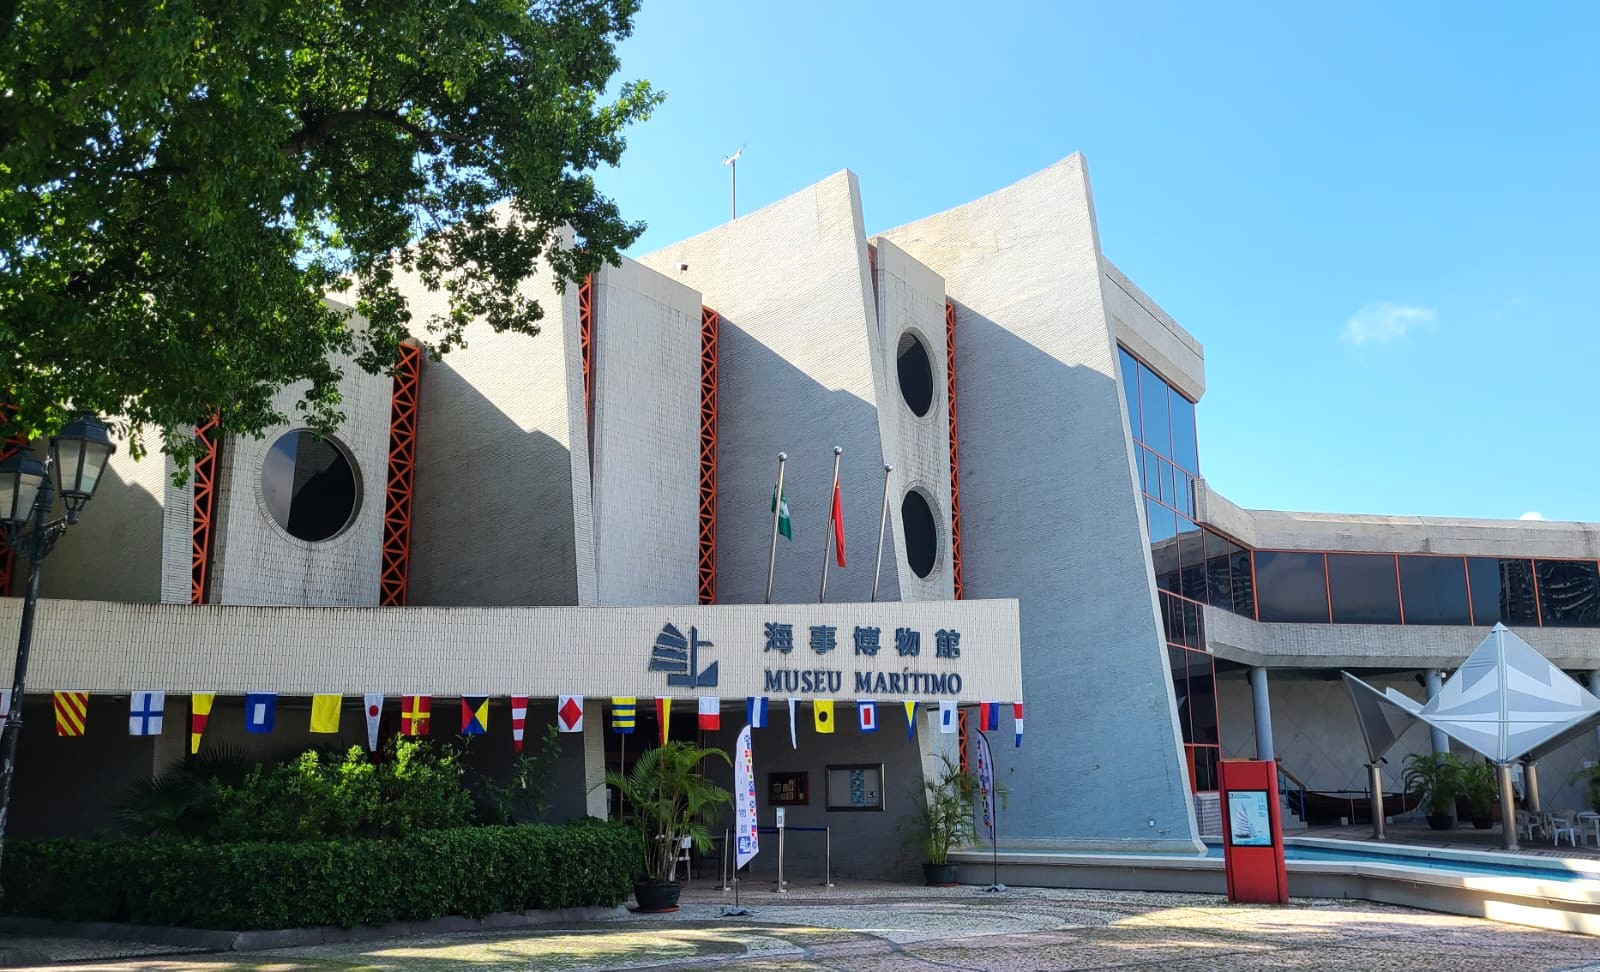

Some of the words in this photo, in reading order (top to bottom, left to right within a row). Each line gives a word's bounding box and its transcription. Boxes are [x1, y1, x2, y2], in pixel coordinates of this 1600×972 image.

[764, 622, 961, 659] 海事博物館
[764, 669, 842, 694] MUSEU
[854, 667, 963, 695] MARÍTIMO
